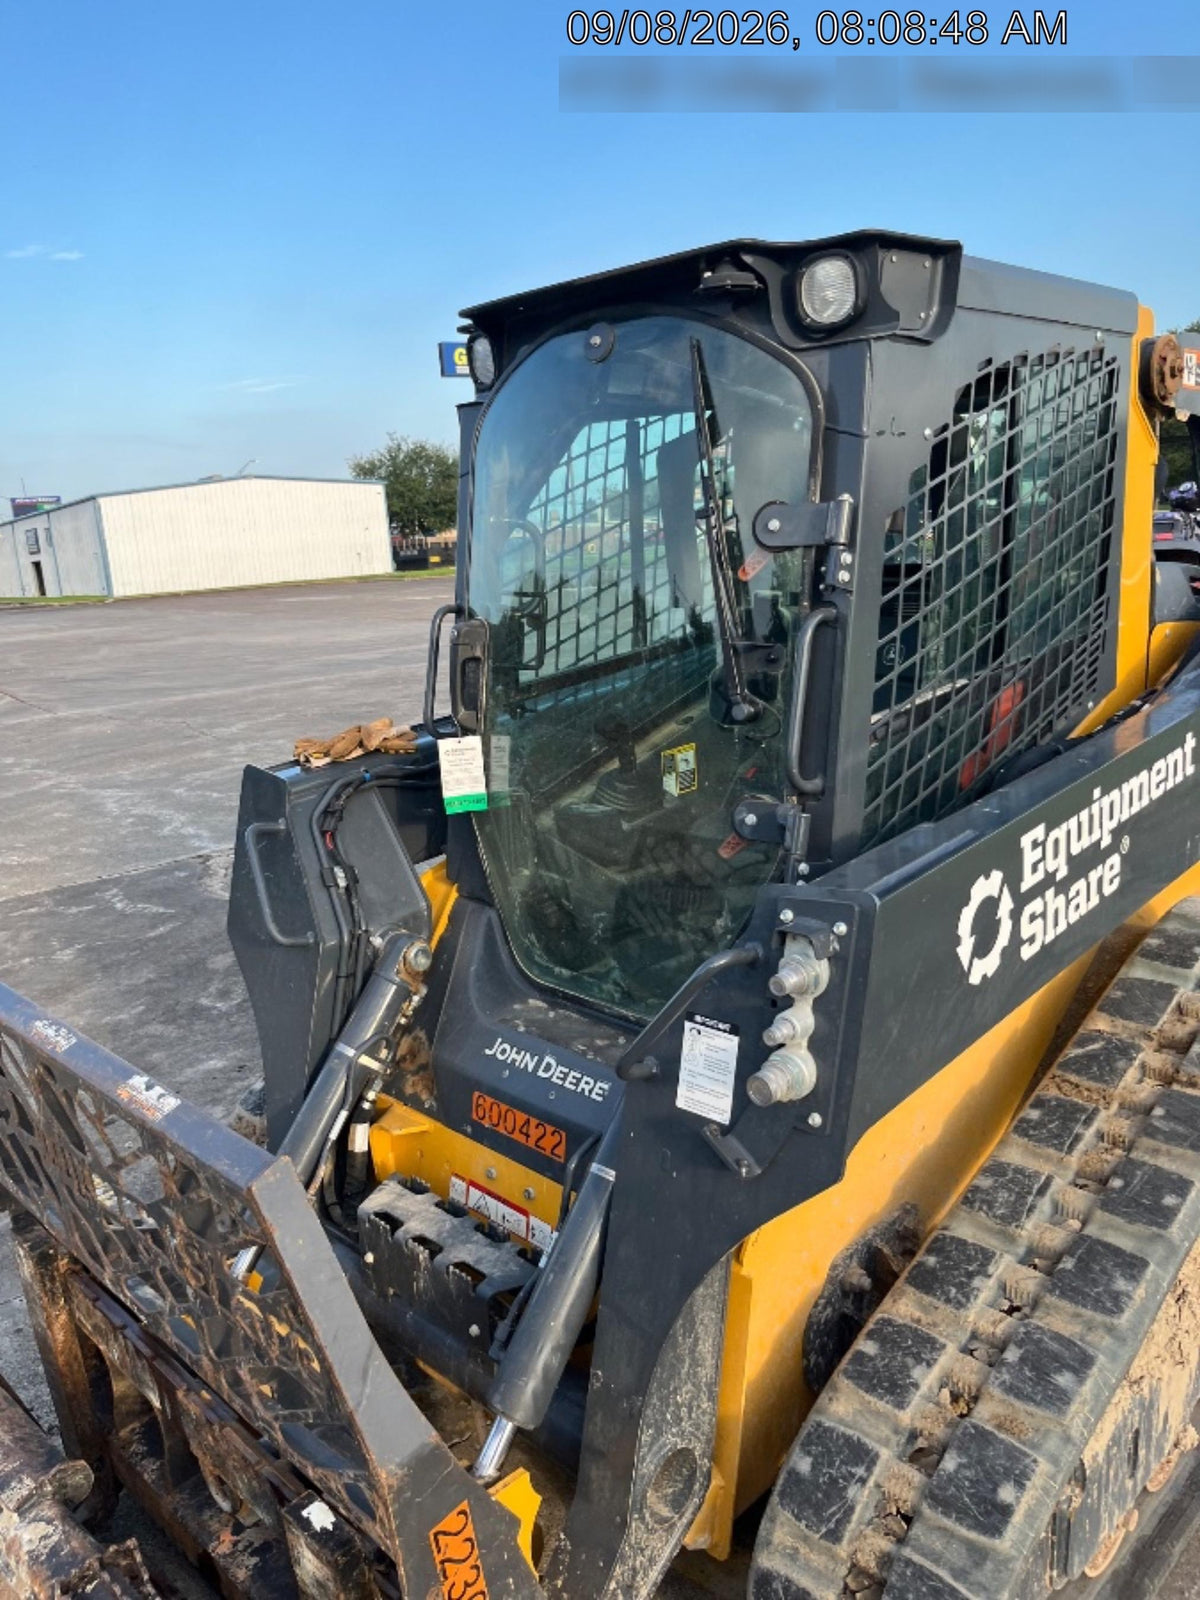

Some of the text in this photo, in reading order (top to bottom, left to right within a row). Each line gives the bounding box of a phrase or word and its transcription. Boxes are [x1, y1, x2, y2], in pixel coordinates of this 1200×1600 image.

[1020, 732, 1197, 893] Equipment
[484, 1037, 611, 1102] JOHN DEERE
[473, 1092, 566, 1160] 600422
